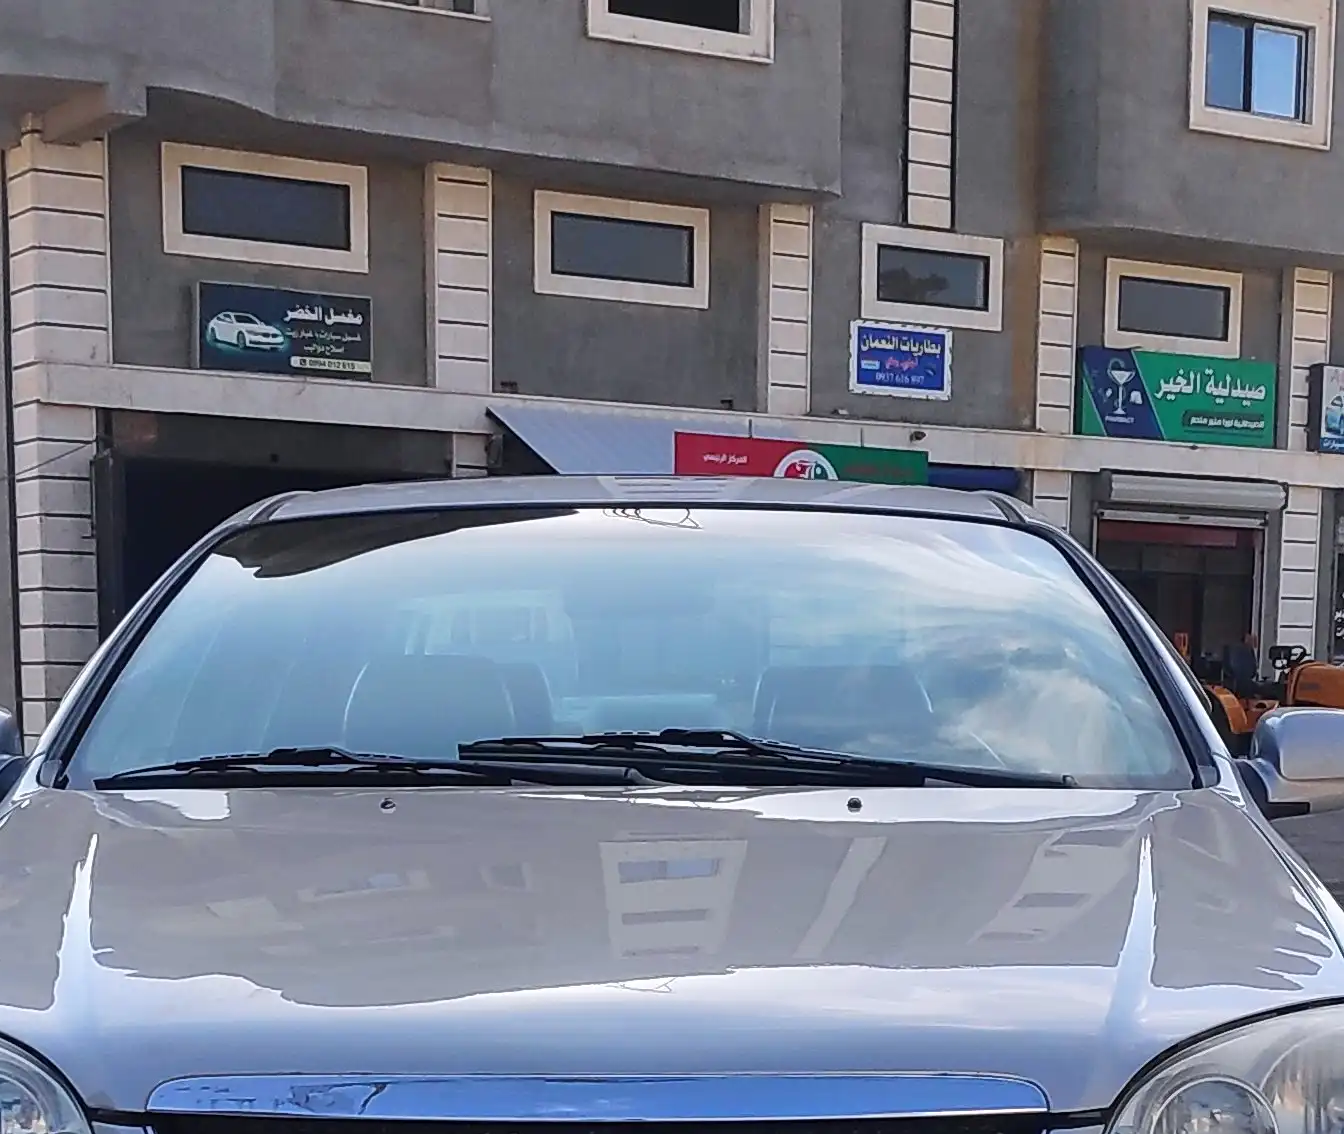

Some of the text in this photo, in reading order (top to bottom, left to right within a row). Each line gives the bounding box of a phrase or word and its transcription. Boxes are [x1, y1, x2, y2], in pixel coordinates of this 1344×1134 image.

[283, 304, 363, 325] مغسل الخضر
[860, 333, 942, 359] بطاريات النعمان
[1154, 367, 1267, 408] صيدلية الخير
[703, 453, 749, 465] المركز الرئيسي
